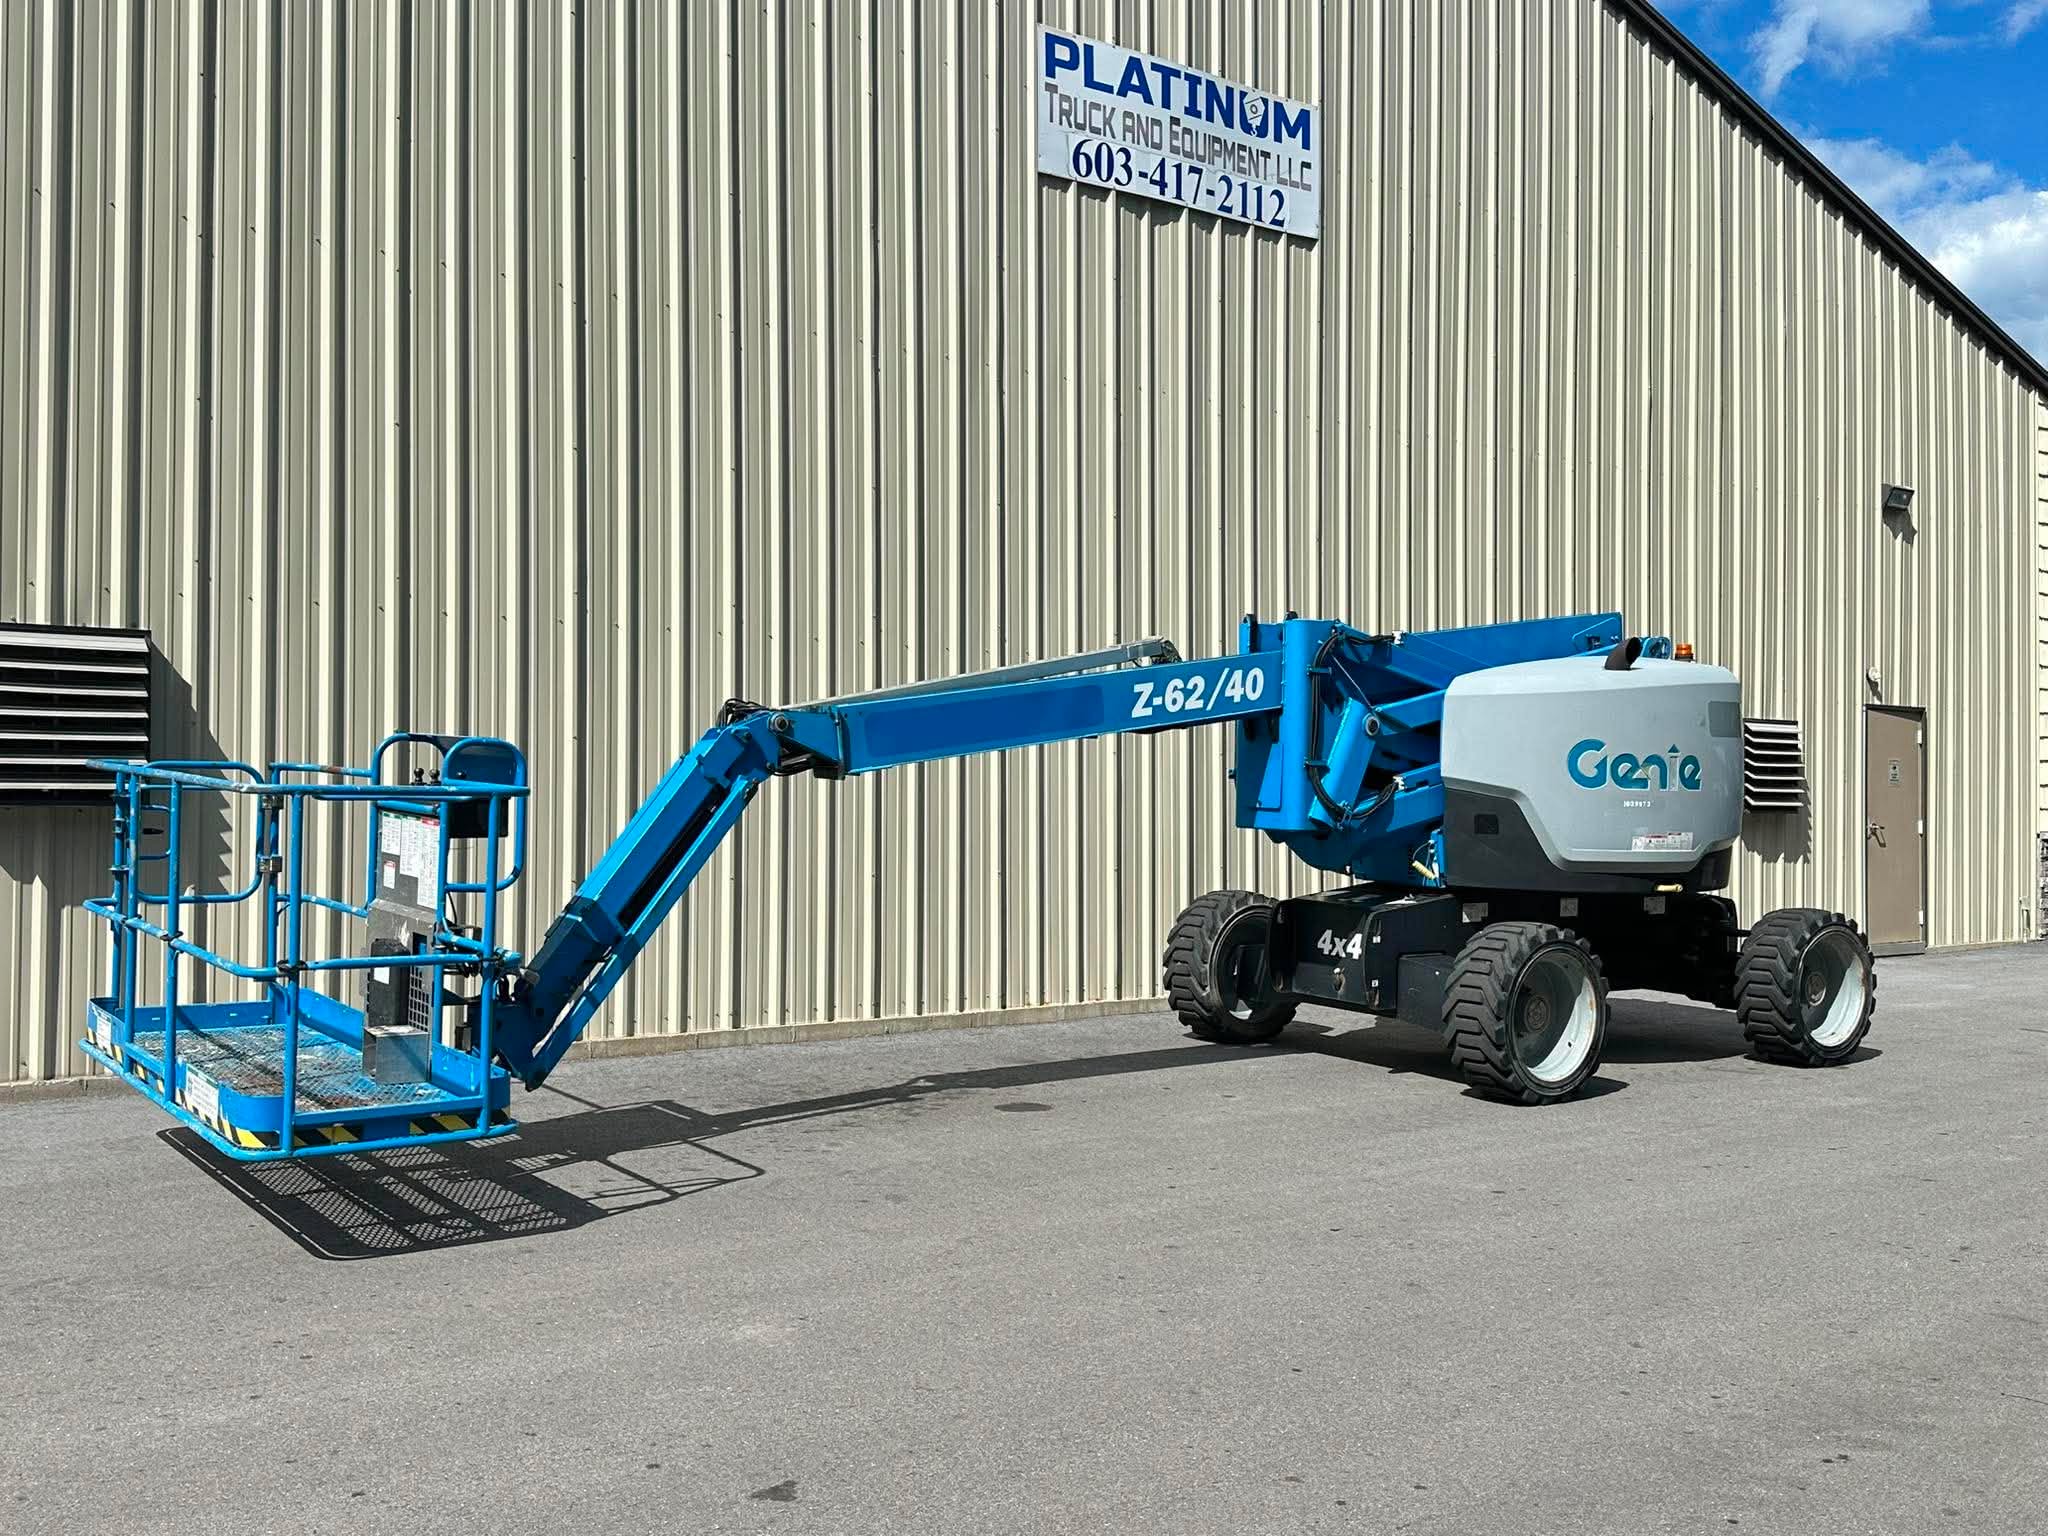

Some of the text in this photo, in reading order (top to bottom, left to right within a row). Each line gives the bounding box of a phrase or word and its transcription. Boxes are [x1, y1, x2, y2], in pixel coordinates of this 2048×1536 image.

[1044, 32, 1311, 151] PLATINUM
[1044, 82, 1312, 192] TRUCK AND EQUIPMENT LLC
[1072, 139, 1286, 227] 603-417-2112
[1131, 667, 1264, 718] Z-62/40
[1567, 738, 1702, 792] Genie
[1317, 928, 1363, 960] 4x4
